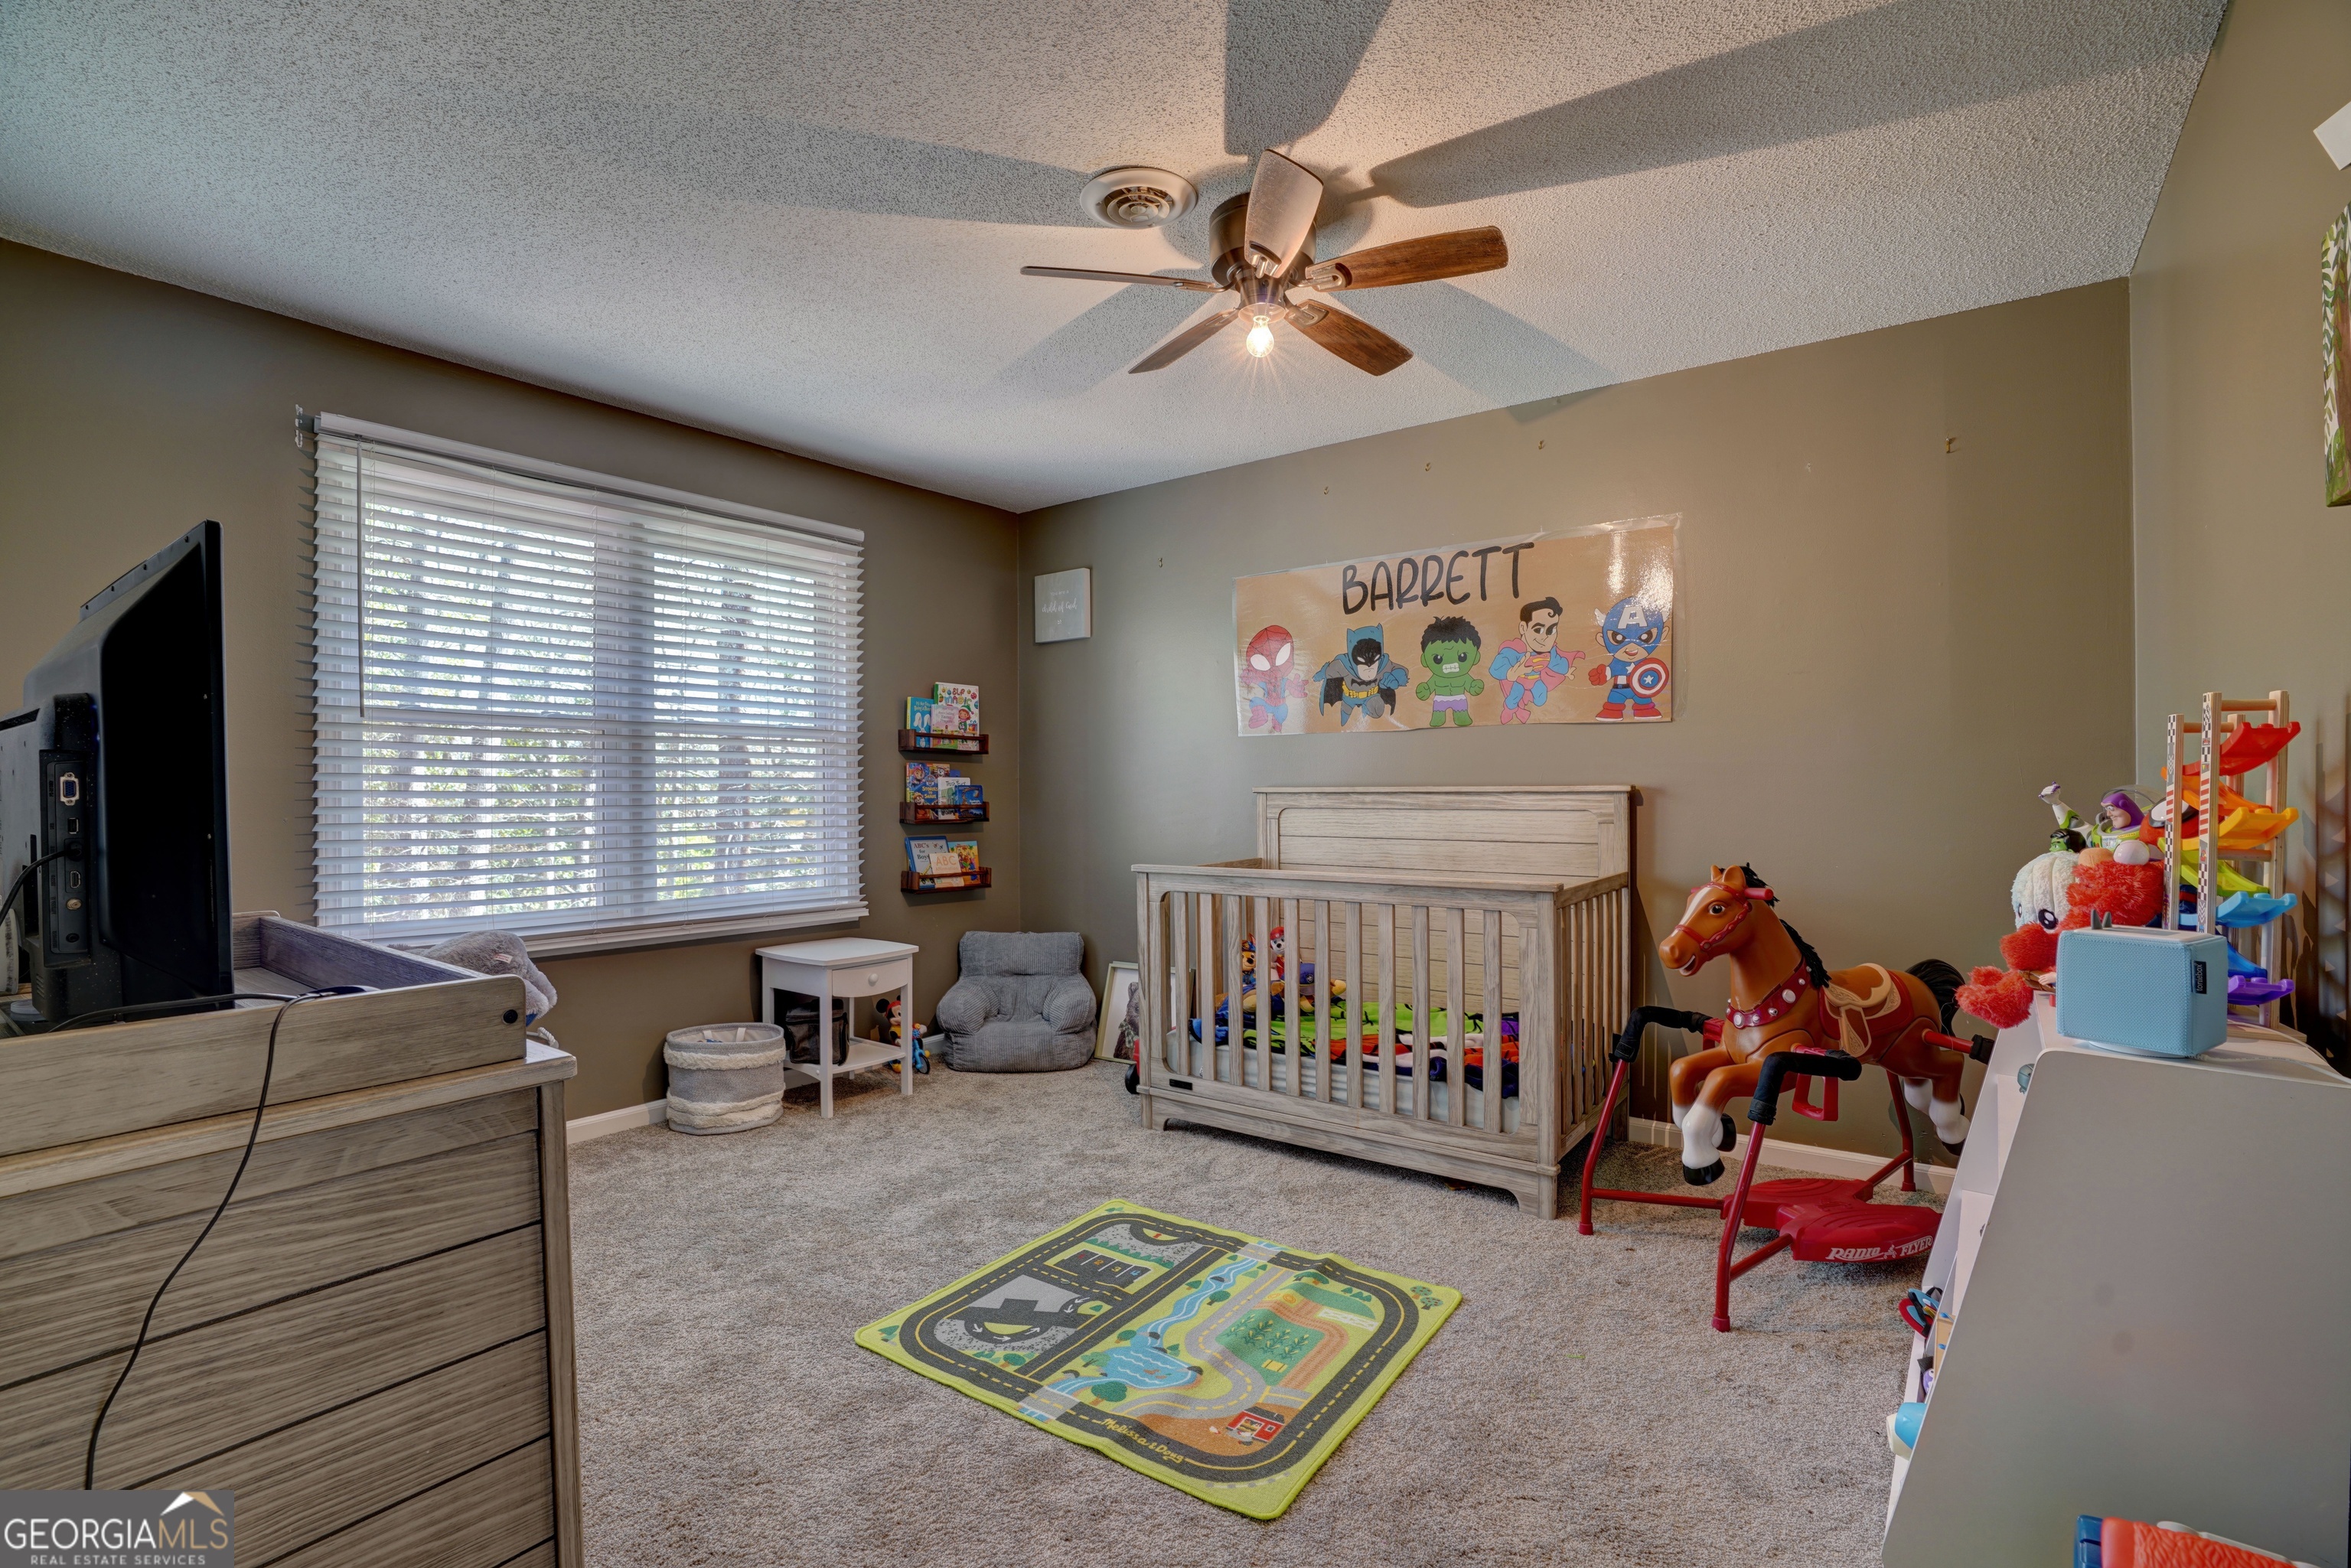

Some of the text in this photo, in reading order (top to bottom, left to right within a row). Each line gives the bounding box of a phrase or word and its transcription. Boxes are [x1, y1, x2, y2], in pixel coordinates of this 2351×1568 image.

[1342, 542, 1534, 615] BARRETT
[1065, 598, 1078, 610] God
[936, 855, 957, 866] ABC
[1825, 1237, 1933, 1260] RADIO FLYER
[1102, 1417, 1149, 1446] Melissa
[1155, 1443, 1185, 1464] Doug
